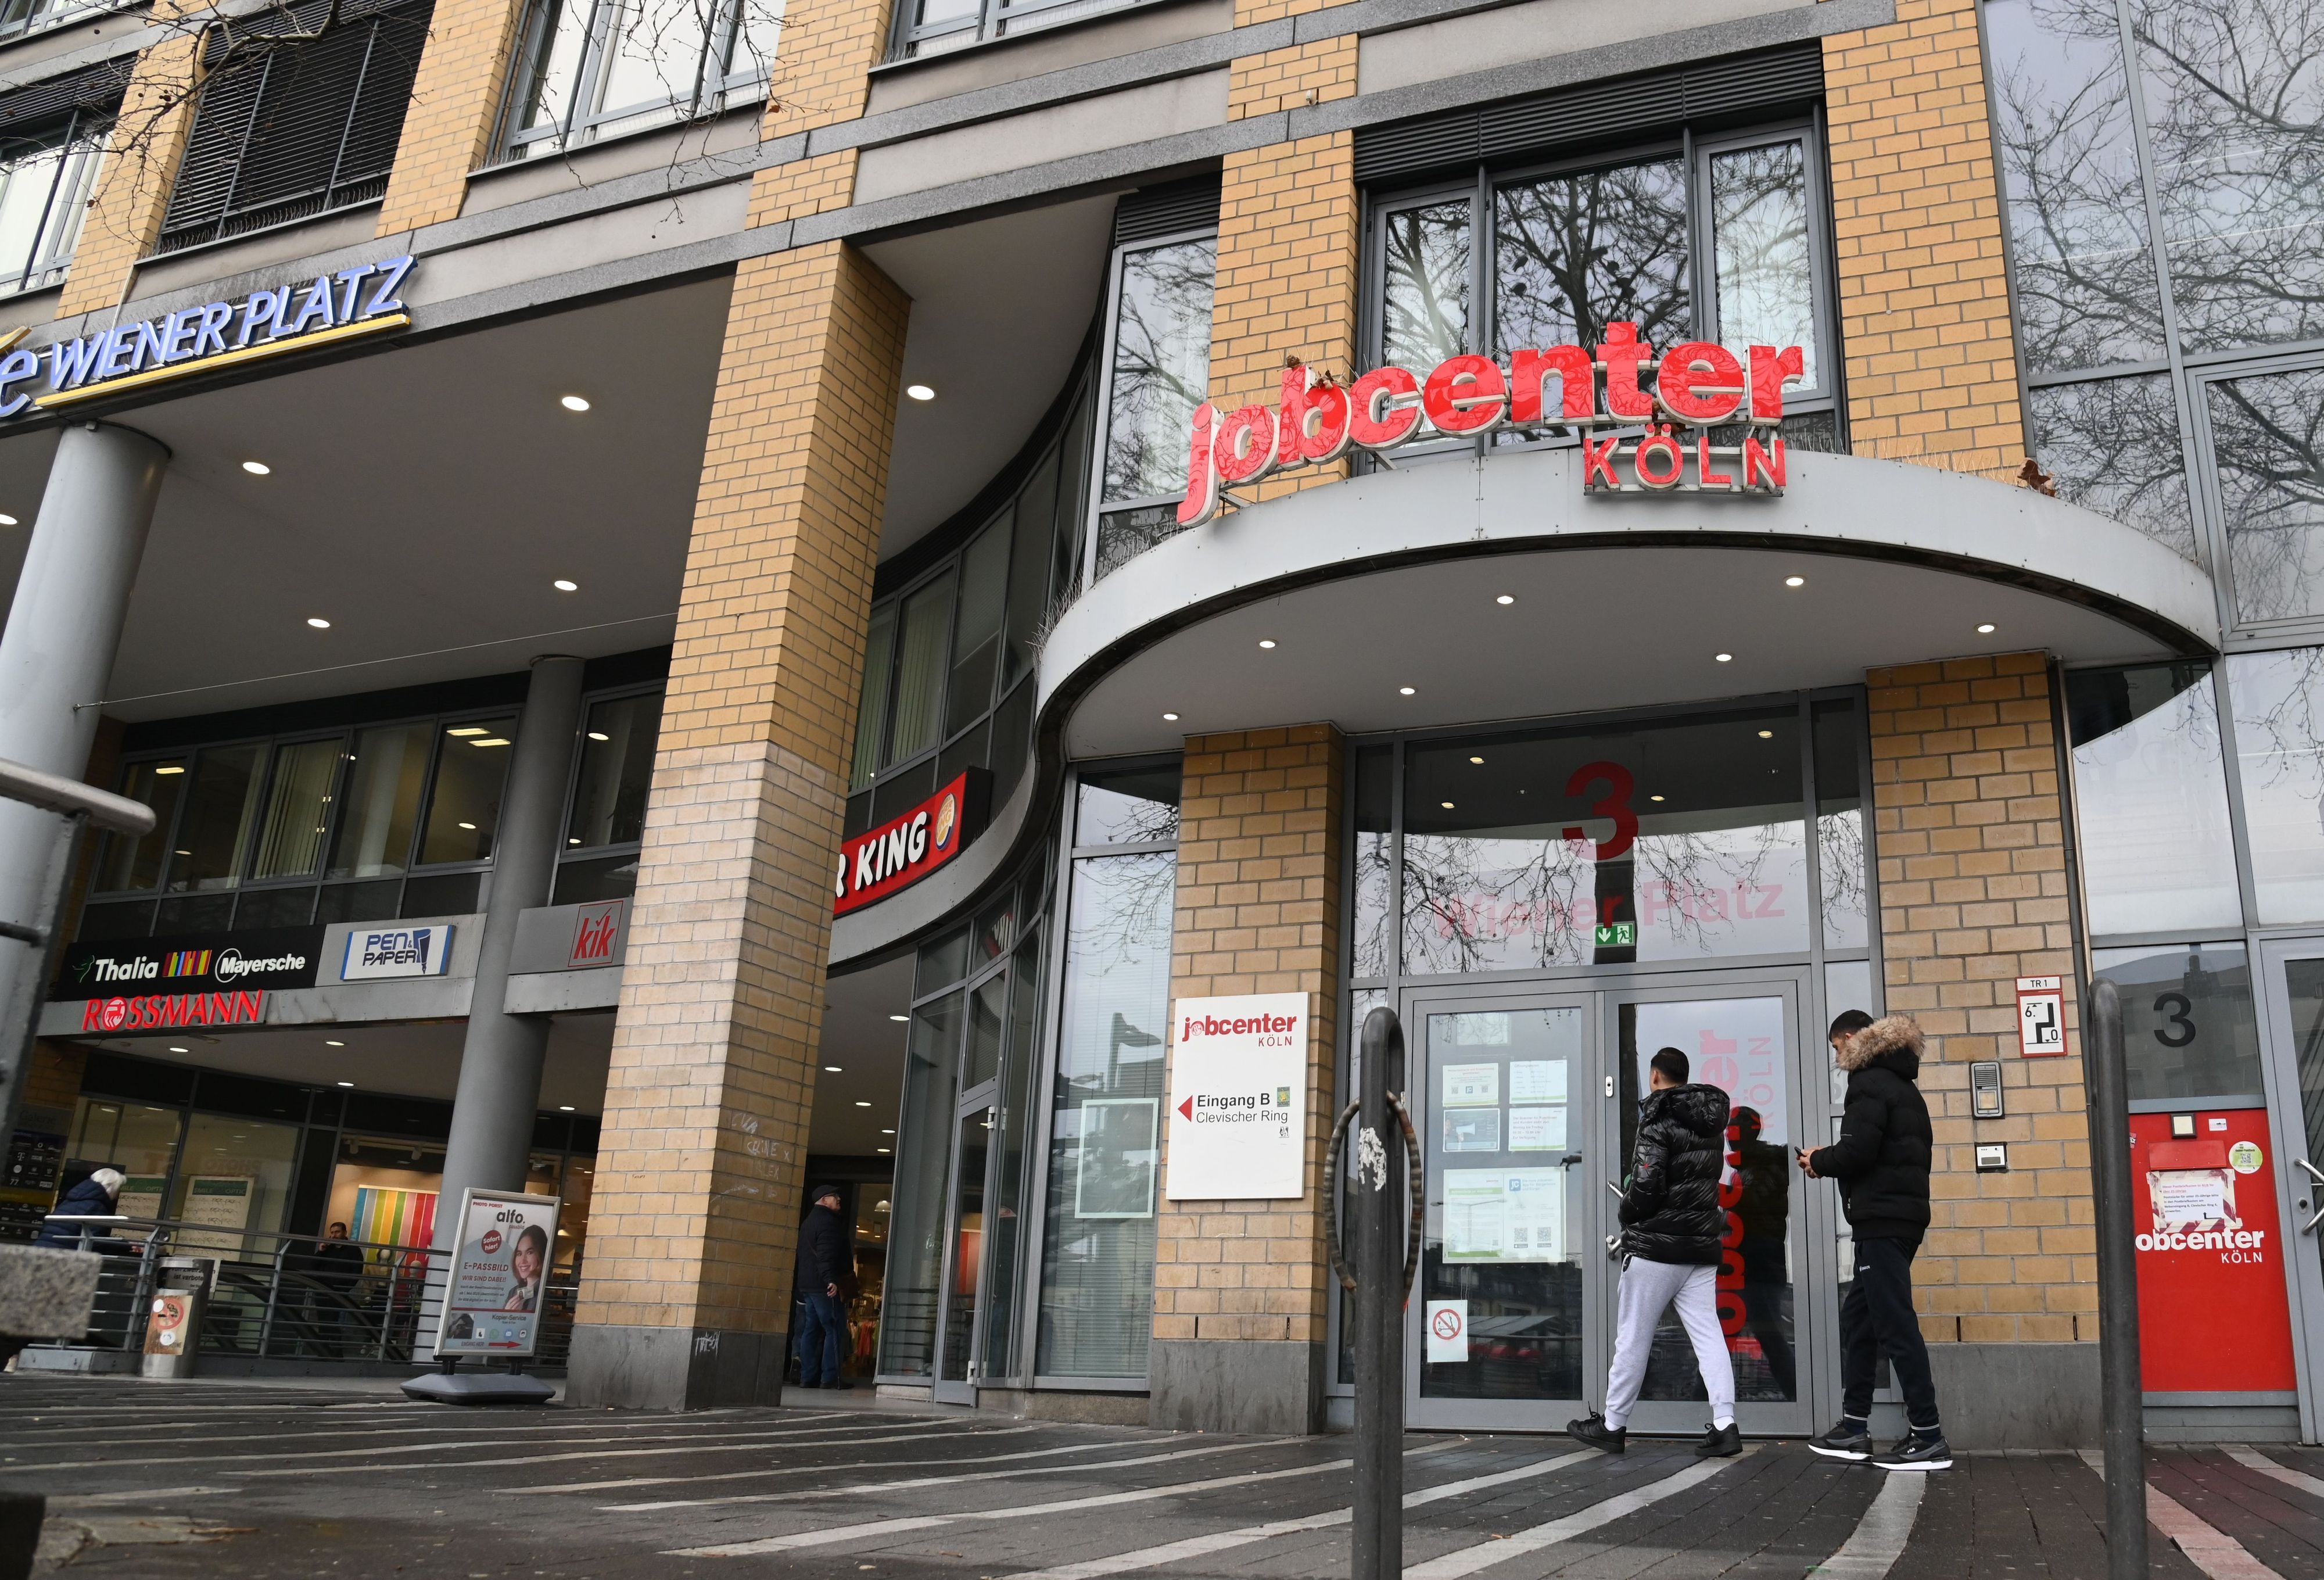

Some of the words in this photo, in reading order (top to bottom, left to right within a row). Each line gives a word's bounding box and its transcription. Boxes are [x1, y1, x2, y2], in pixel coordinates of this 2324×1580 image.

[50, 301, 235, 390] WIENER
[239, 255, 418, 346] PLATZ
[1177, 321, 1803, 528] jobcenter
[1583, 423, 1787, 496] KÖLN
[1562, 761, 1638, 861] 3
[855, 811, 927, 891] KING
[1431, 891, 1624, 938] Wiener
[1643, 879, 1785, 926] Platz
[365, 932, 408, 952] PEN
[408, 940, 412, 948] &
[573, 908, 615, 959] kik
[94, 956, 159, 982] Thalia
[220, 953, 305, 974] Mayersche
[363, 950, 417, 966] PAPER
[83, 988, 263, 1031] ROSSMANN
[2025, 1006, 2035, 1017] 6.
[2153, 993, 2196, 1047] 3
[1258, 1034, 1292, 1047] KÖLN
[2051, 1029, 2061, 1041] 0.
[1744, 1037, 1775, 1129] KÖLN
[1197, 1094, 1256, 1109] Eingang
[1260, 1093, 1270, 1105] B
[1196, 1111, 1257, 1123] Clevischer
[1261, 1110, 1288, 1123] Ring
[497, 1209, 525, 1224] alfo.
[483, 1235, 500, 1244] Sofort
[2135, 1228, 2264, 1251] obcenter
[464, 1262, 508, 1271] E-PASSBILD
[2221, 1249, 2263, 1264] KÖLN
